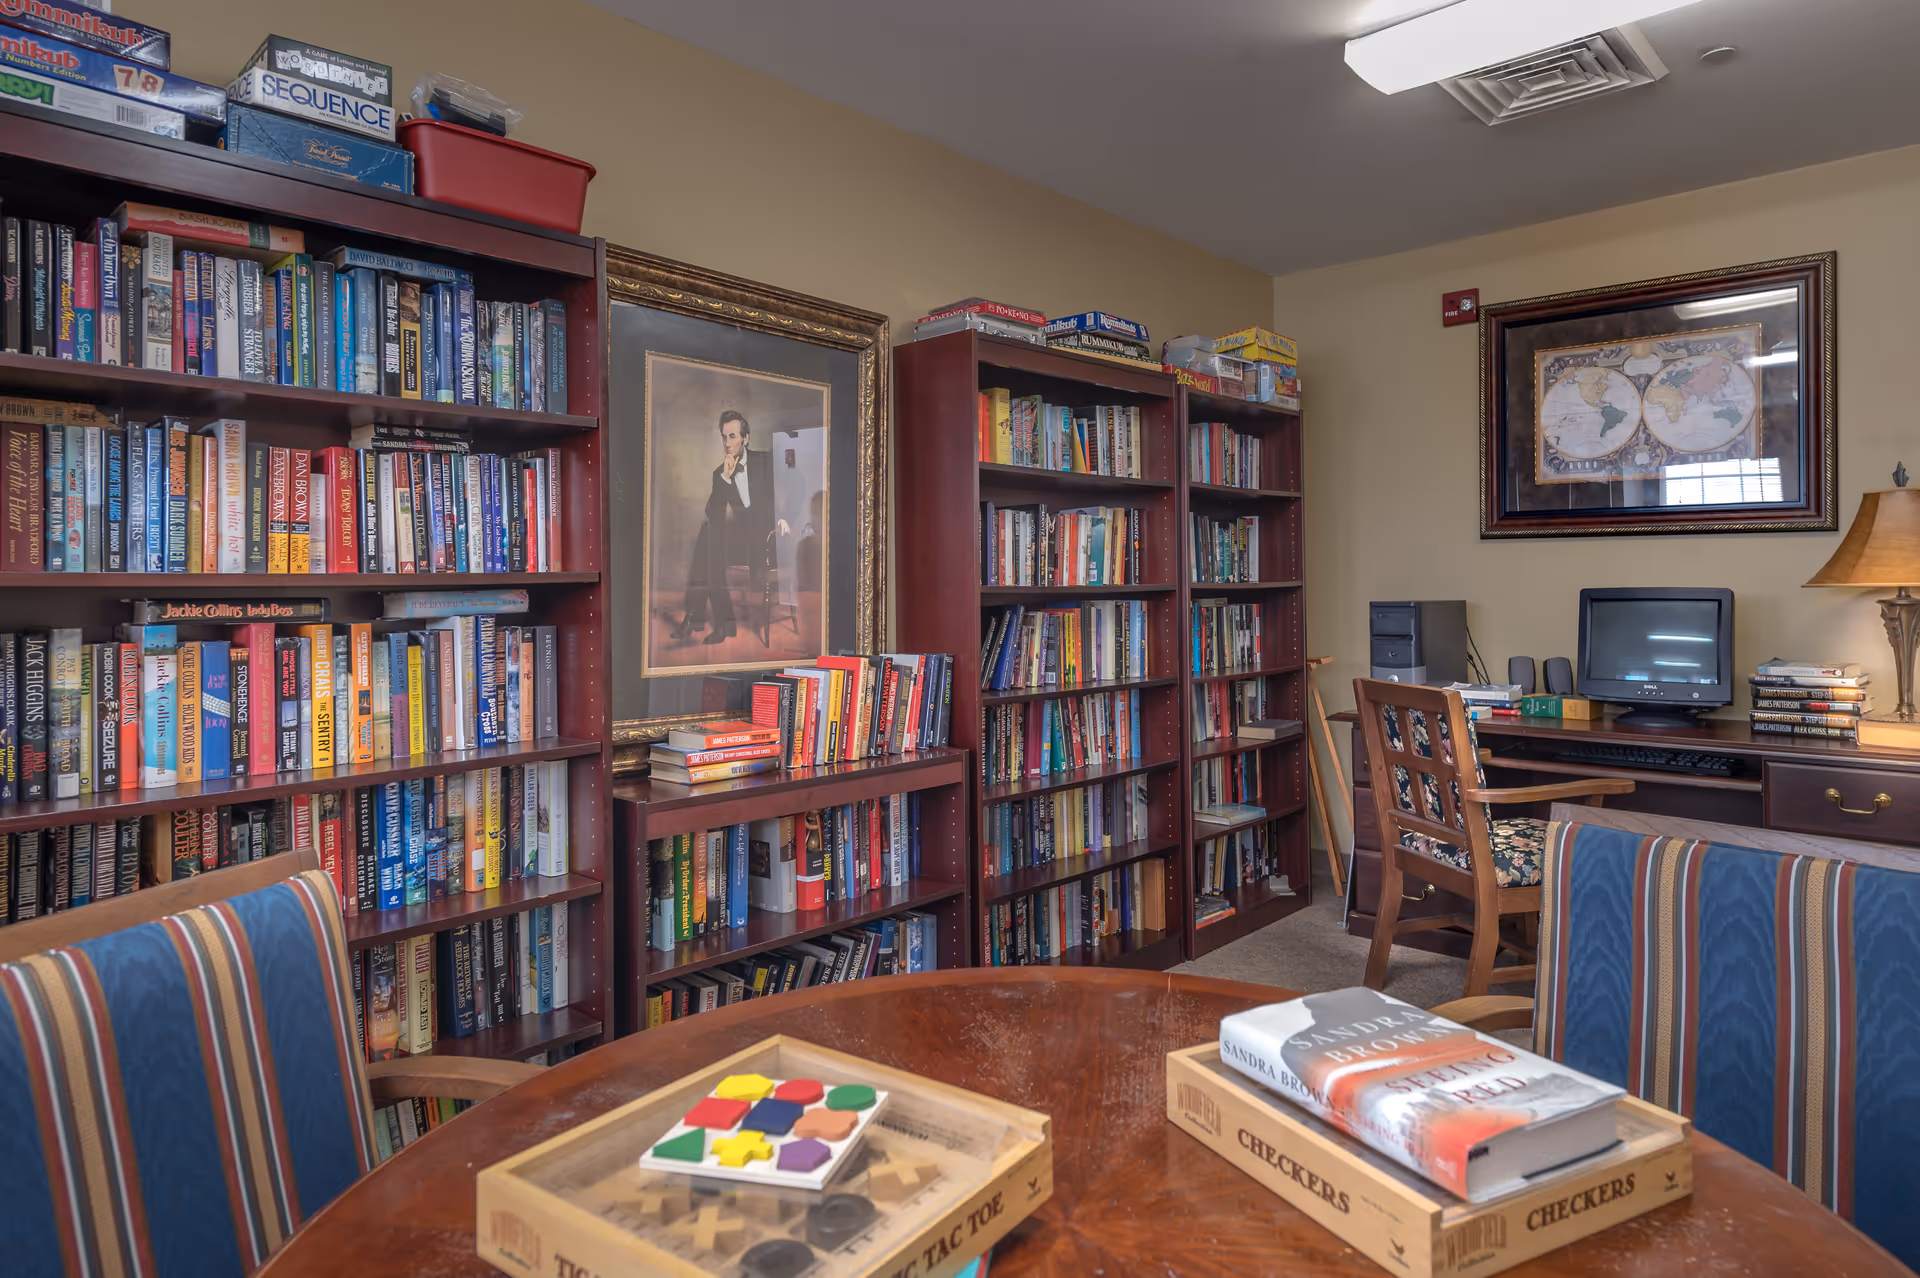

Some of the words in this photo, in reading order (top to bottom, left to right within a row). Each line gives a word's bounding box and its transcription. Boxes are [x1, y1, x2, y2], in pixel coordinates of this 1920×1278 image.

[56, 24, 84, 37] PEOPLE
[6, 53, 51, 72] Numbers
[52, 66, 87, 82] Edition
[311, 49, 329, 60] GAME
[262, 73, 391, 131] SEQUENCE
[103, 238, 116, 252] On
[153, 235, 162, 277] COURAGE
[103, 252, 116, 273] Your
[349, 251, 377, 265] DAVID
[376, 255, 414, 273] BALDACCI
[103, 274, 116, 298] Own
[243, 275, 254, 317] BARBIERI
[1099, 312, 1137, 334] Rummikub
[1445, 310, 1459, 318] FIRE
[243, 328, 254, 374] STRANGER
[1080, 334, 1124, 352] RUMMIKUB
[459, 366, 475, 401] SCANDAL
[9, 430, 28, 459] Voice
[30, 432, 40, 475] BARBARA
[109, 435, 122, 459] LOOSE
[224, 423, 241, 460] SANDRA
[382, 440, 408, 449] SANDRA
[5, 465, 28, 477] of
[109, 458, 122, 484] AMONG
[131, 446, 144, 479] FLAGS
[169, 447, 186, 496] JOHANSEN
[273, 450, 286, 476] DAN
[295, 452, 308, 477] DAN
[432, 463, 442, 489] HARLAN
[9, 476, 28, 494] the
[30, 475, 40, 512] TAYLOR
[109, 484, 122, 497] THE
[273, 477, 286, 521] BROWN
[414, 483, 425, 511] Women
[9, 495, 28, 533] Heart
[109, 497, 122, 521] LAMBS
[150, 502, 160, 521] Dead
[169, 500, 186, 524] DARK
[295, 479, 308, 522] BROWN
[131, 493, 144, 540] FATHERS
[226, 500, 244, 531] white
[469, 505, 481, 528] Clark
[30, 513, 40, 565] BRADFORD
[149, 523, 160, 550] BRETT
[169, 525, 186, 562] SUMMER
[228, 535, 245, 554] hot
[160, 603, 203, 619] Jackie
[203, 603, 243, 618] Collins
[246, 603, 271, 618] Lady
[270, 603, 294, 616] Boss
[316, 629, 328, 659] ROBERT
[480, 617, 497, 654] PATRICIA
[5, 640, 15, 663] MARY
[25, 637, 48, 667] JACK
[66, 658, 76, 673] PAT
[103, 647, 114, 674] ROBIN
[182, 646, 196, 669] JACKIE
[282, 649, 290, 665] GIRL
[544, 634, 553, 670] REUNION
[5, 664, 15, 696] HIGGINS
[55, 646, 67, 687] CONROY
[120, 649, 138, 687] ROBIN
[155, 655, 170, 693] Jackie
[282, 665, 290, 679] ARE
[314, 661, 331, 698] CRAIS
[395, 668, 405, 690] WORK
[480, 653, 497, 699] CORNWELL
[881, 660, 893, 685] JAMES
[24, 669, 46, 722] HIGGINS
[103, 675, 114, 700] COOK
[182, 671, 196, 700] COLLINS
[237, 665, 248, 724] STONEHENGE
[944, 669, 952, 704] DESECRATION
[1773, 689, 1808, 698] PATTERSON
[5, 697, 15, 726] CLARK
[121, 688, 138, 726] COOK
[155, 696, 170, 738] Collins
[319, 701, 327, 712] THE
[487, 697, 499, 736] Southern
[879, 685, 892, 733] PATTERSON
[1753, 712, 1770, 721] JAMES
[1770, 712, 1802, 723] PATTERSON
[1756, 700, 1772, 708] JAMES
[1772, 700, 1800, 709] PATTERSON
[182, 703, 196, 747] HOLLYWOOD
[317, 713, 331, 753] SENTRY
[480, 711, 492, 734] Cross
[1754, 723, 1769, 732] JAMES
[1769, 724, 1792, 733] PATTERSON
[1793, 727, 1807, 735] ALEX
[1807, 727, 1828, 736] CROSS,
[1827, 729, 1841, 737] RUN
[1805, 716, 1818, 724] STEP
[1831, 717, 1849, 725] CRACK
[60, 739, 72, 772] BROAD
[102, 720, 116, 770] SEIZURE
[182, 748, 196, 764] KIDS
[240, 729, 249, 756] Bernard
[793, 730, 803, 757] BURN
[6, 745, 17, 782] Cinderella
[21, 744, 34, 781] COMPANY
[33, 751, 47, 772] BAD
[527, 768, 536, 791] HARLAN
[490, 798, 499, 827] SCONES
[527, 791, 537, 811] COBEN
[360, 793, 370, 849] DISCLOSURE
[411, 799, 421, 837] CUSSLER
[202, 812, 212, 861] COULTER
[323, 824, 335, 855] REBEL
[408, 837, 419, 865] CHASE
[697, 832, 706, 862] JOHN
[356, 854, 366, 899] CRICHTON
[366, 855, 376, 896] MICHAEL
[428, 854, 439, 880] SHIFT
[679, 860, 691, 870] By
[55, 863, 70, 907] CORNWELL
[681, 870, 691, 891] Order
[698, 865, 706, 896] HART
[680, 894, 691, 930] President
[463, 943, 473, 960] THE
[492, 932, 505, 968] GARDNER
[463, 960, 473, 987] RETURN
[455, 979, 466, 1009] HOLMES
[464, 989, 473, 1001] OF
[1287, 1007, 1429, 1051] SANDRA
[1323, 1022, 1452, 1069] BROWN
[1223, 1038, 1277, 1082] SANDRA
[1280, 1069, 1336, 1112] BROWN
[1384, 1051, 1517, 1093] SEEING
[1451, 1073, 1528, 1106] RED
[1237, 1127, 1350, 1216] CHECKERS
[1525, 1172, 1636, 1232] CHECKERS
[922, 1223, 963, 1274] TAC
[966, 1190, 1005, 1238] TOE
